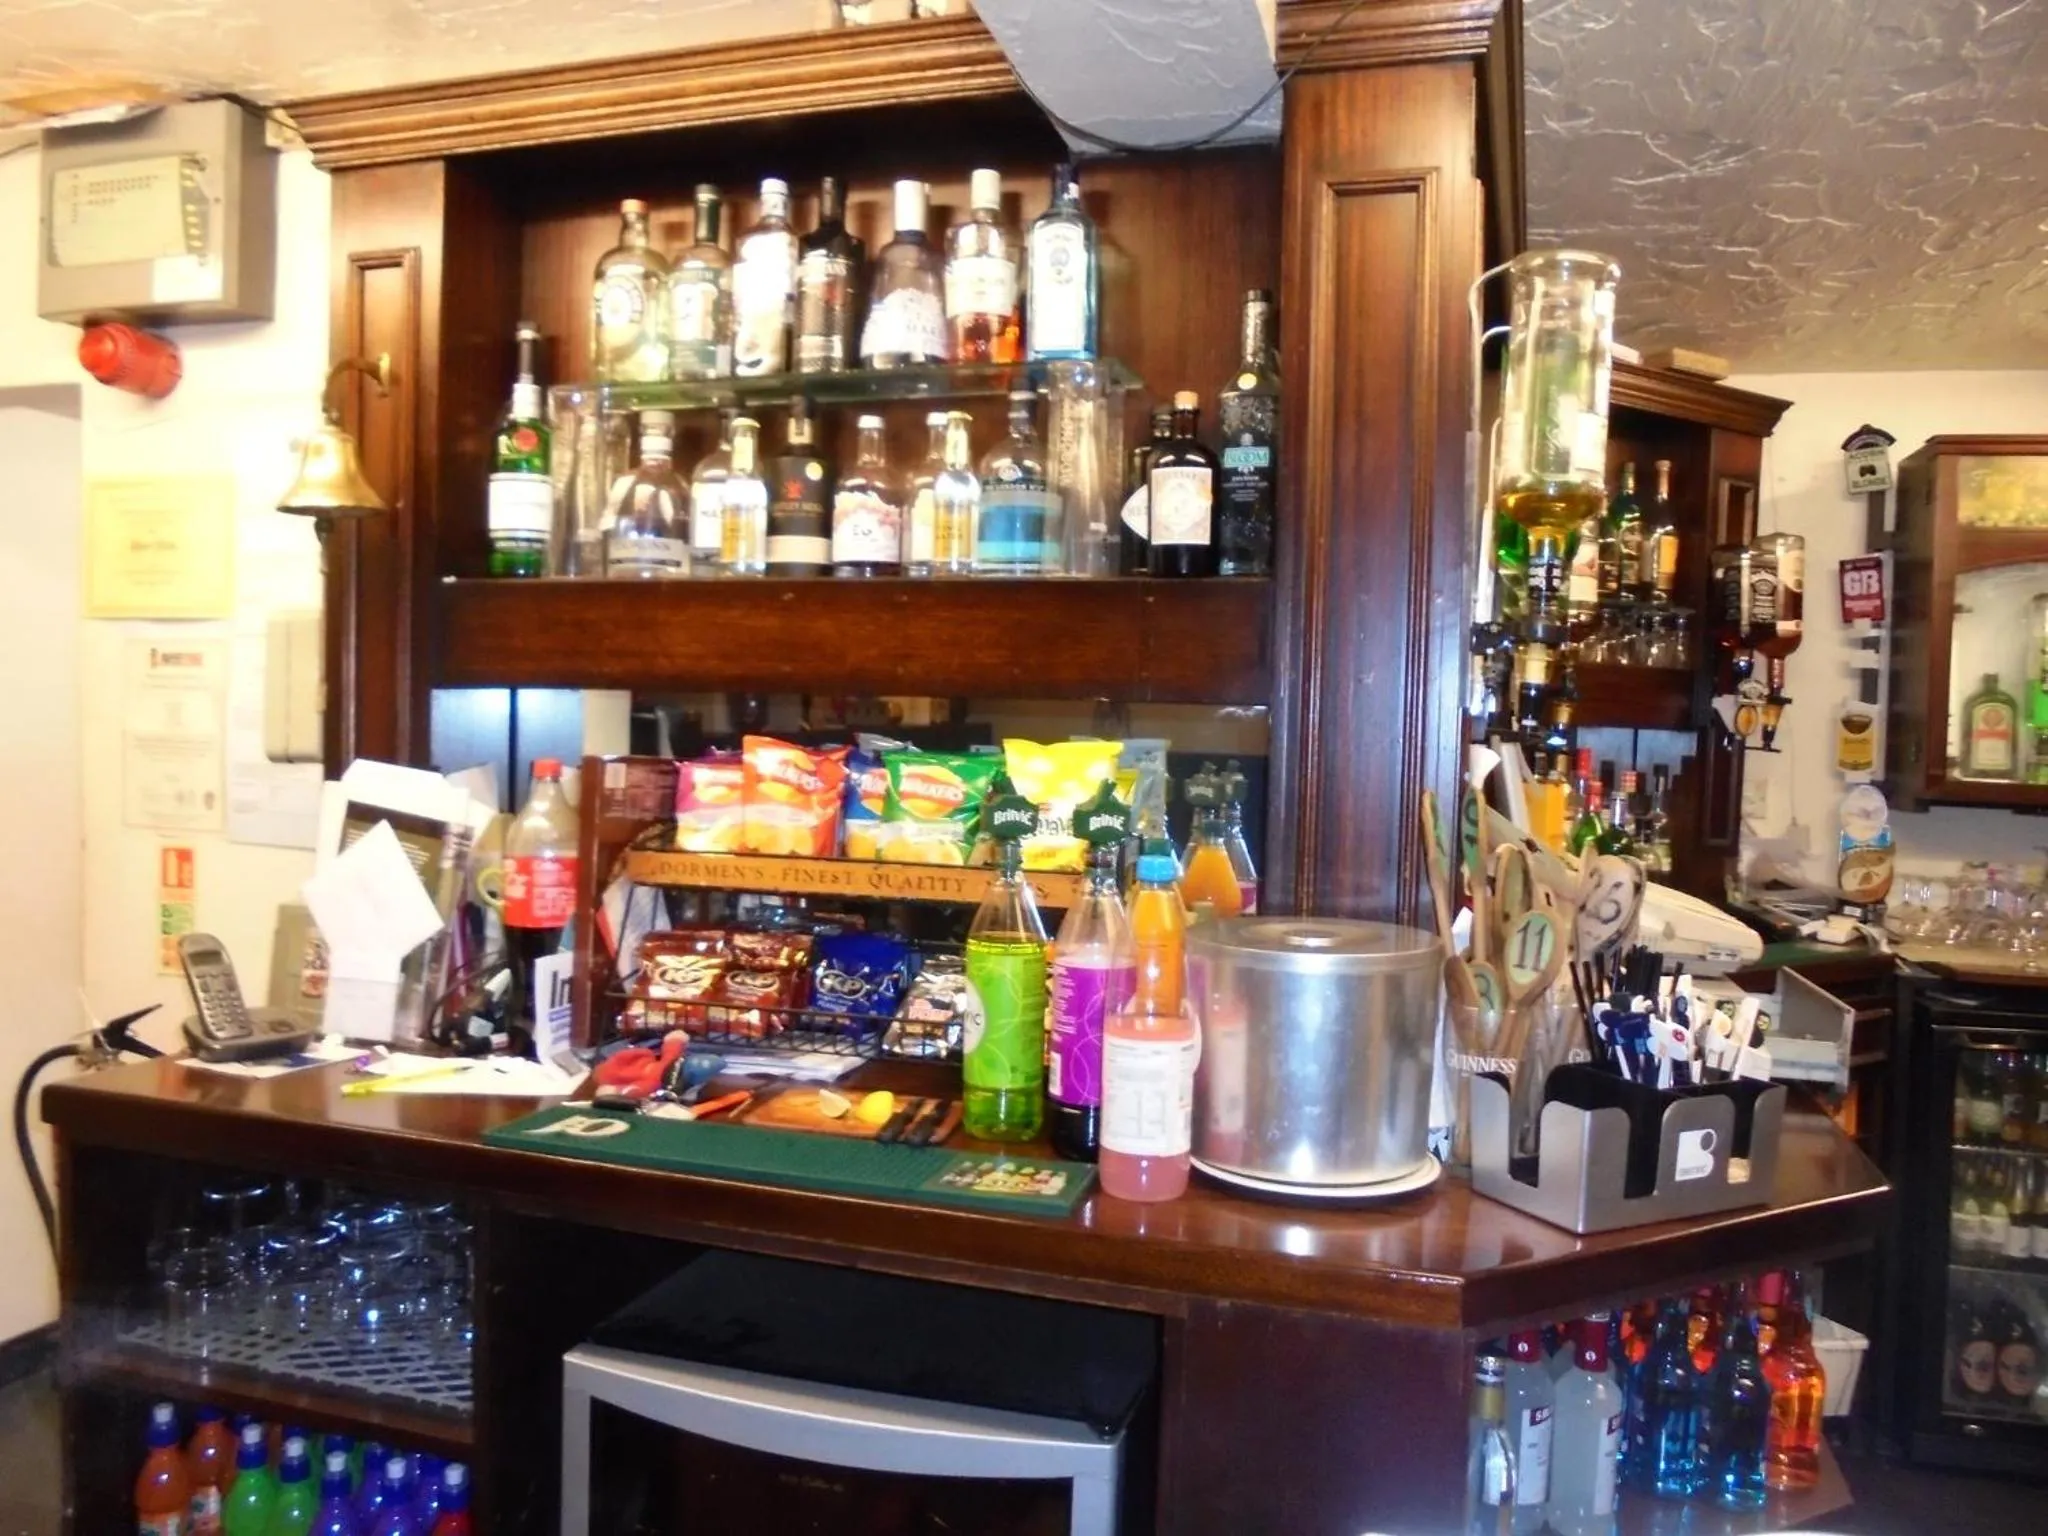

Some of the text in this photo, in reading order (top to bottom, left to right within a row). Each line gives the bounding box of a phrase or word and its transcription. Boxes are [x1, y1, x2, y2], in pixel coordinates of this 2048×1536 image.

[994, 811, 1032, 826] Britvic
[1089, 812, 1124, 831] Britvic
[661, 860, 764, 880] DORMEN'S
[782, 867, 853, 886] FINEST
[867, 870, 967, 893] QUALITY
[1512, 919, 1548, 972] 11
[1445, 1049, 1518, 1073] GUINNESS
